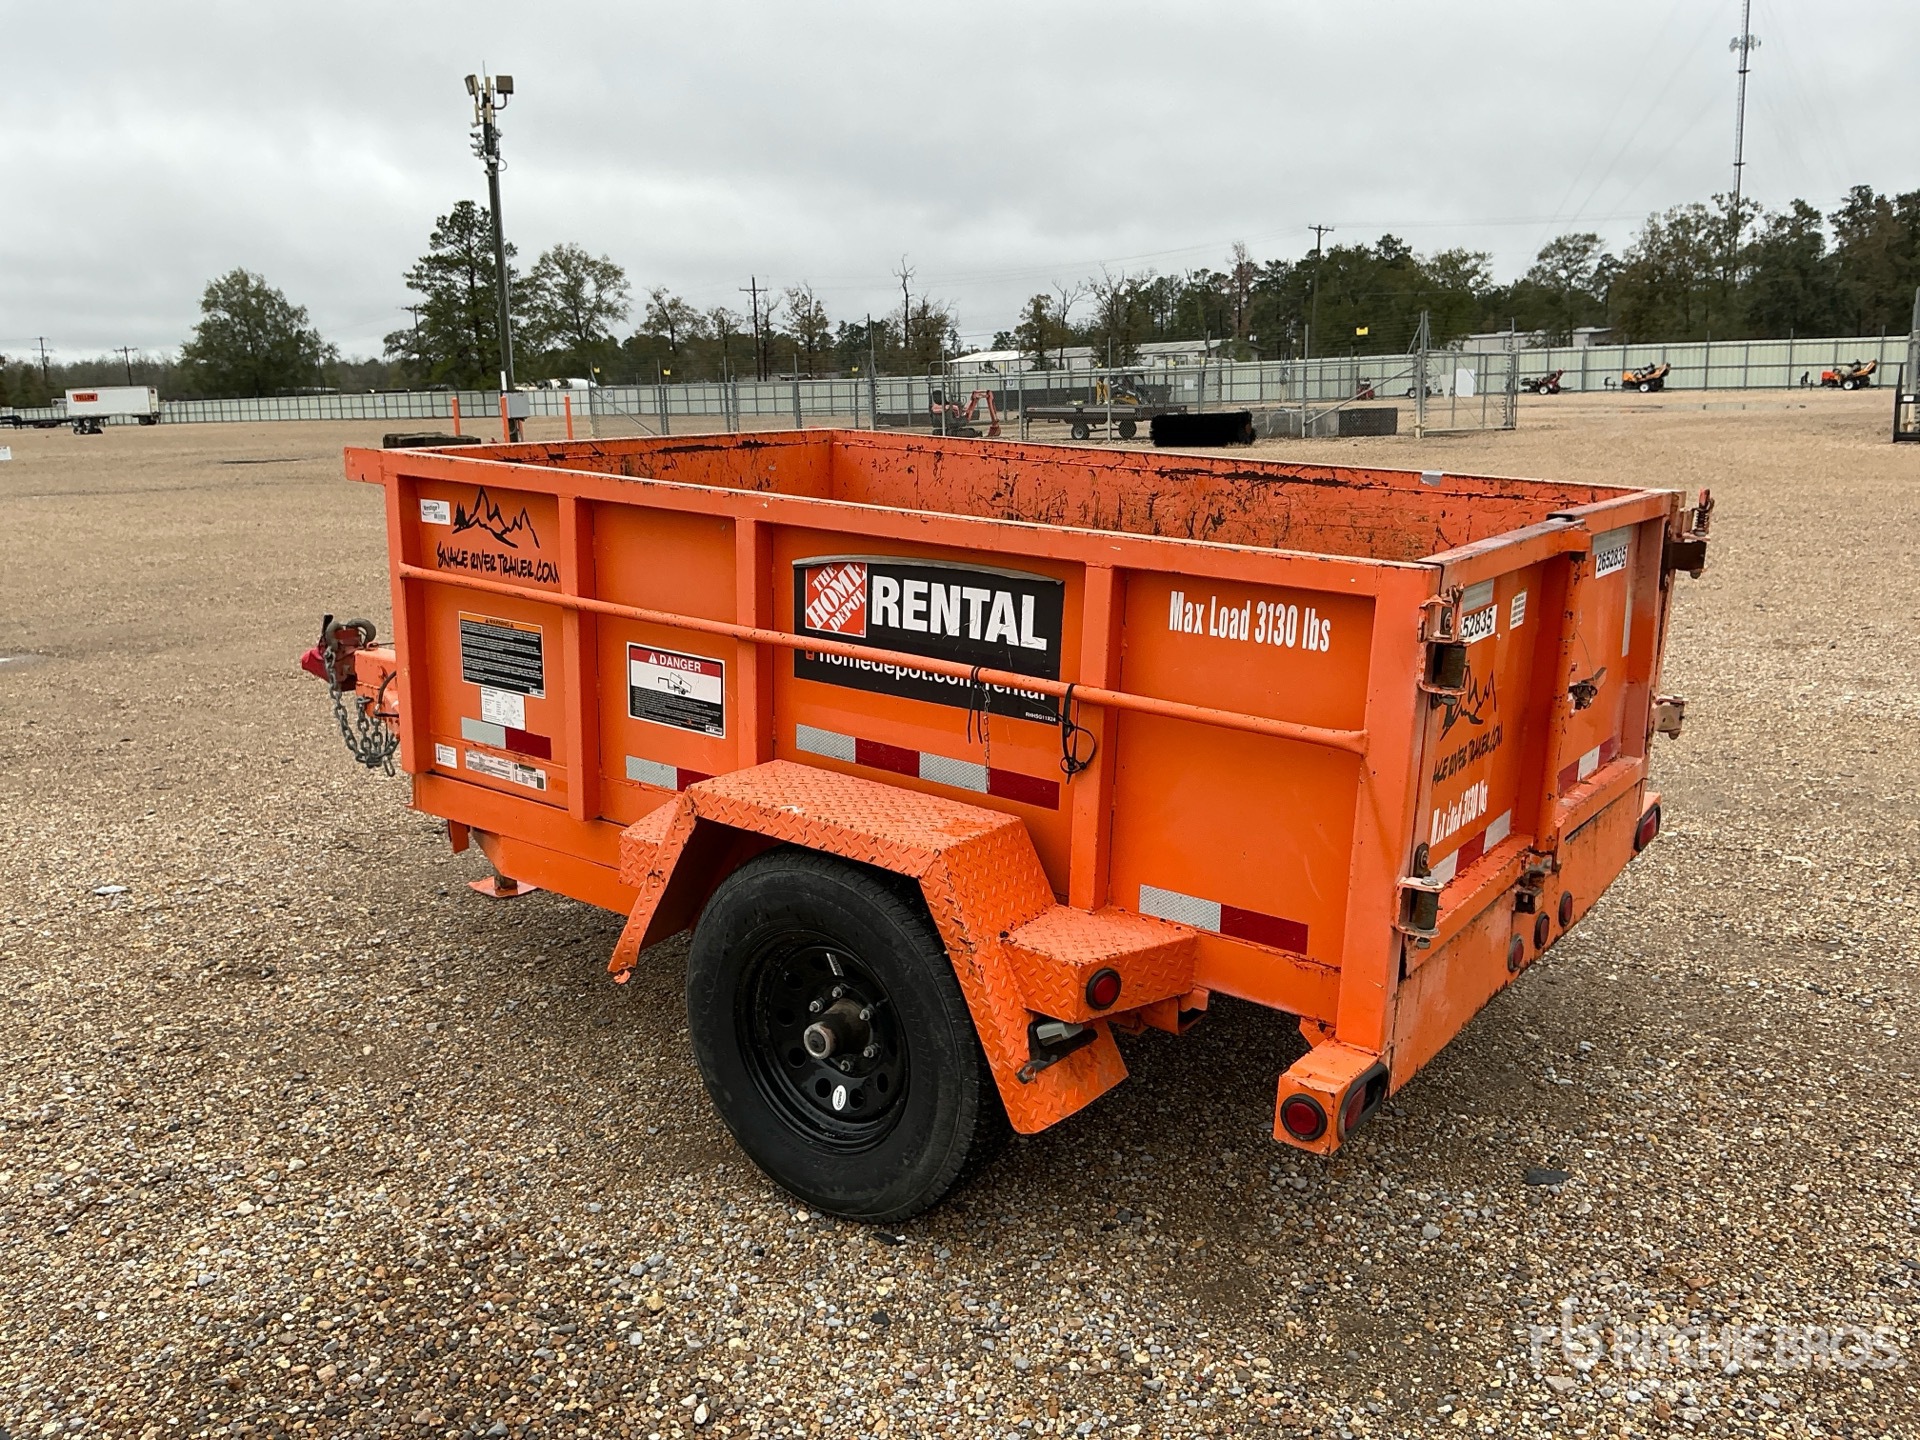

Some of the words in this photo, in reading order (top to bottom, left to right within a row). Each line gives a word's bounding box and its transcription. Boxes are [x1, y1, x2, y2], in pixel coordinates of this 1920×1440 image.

[437, 540, 468, 569] SNAKE
[470, 549, 497, 573] RIVER
[497, 553, 560, 584] TRAILER.COM
[811, 564, 838, 592] THE
[1597, 546, 1627, 572] 2652835
[806, 563, 867, 630] HOME
[828, 588, 867, 632] DEPOT
[871, 575, 1047, 650] RENTAL
[1168, 591, 1205, 634] Max
[1209, 596, 1251, 641] Load
[1254, 601, 1298, 648] 3130
[1301, 607, 1331, 652] lbs
[1460, 607, 1494, 638] 52835
[660, 654, 702, 673] DANGER
[819, 650, 1046, 701] omedepot.comrenta
